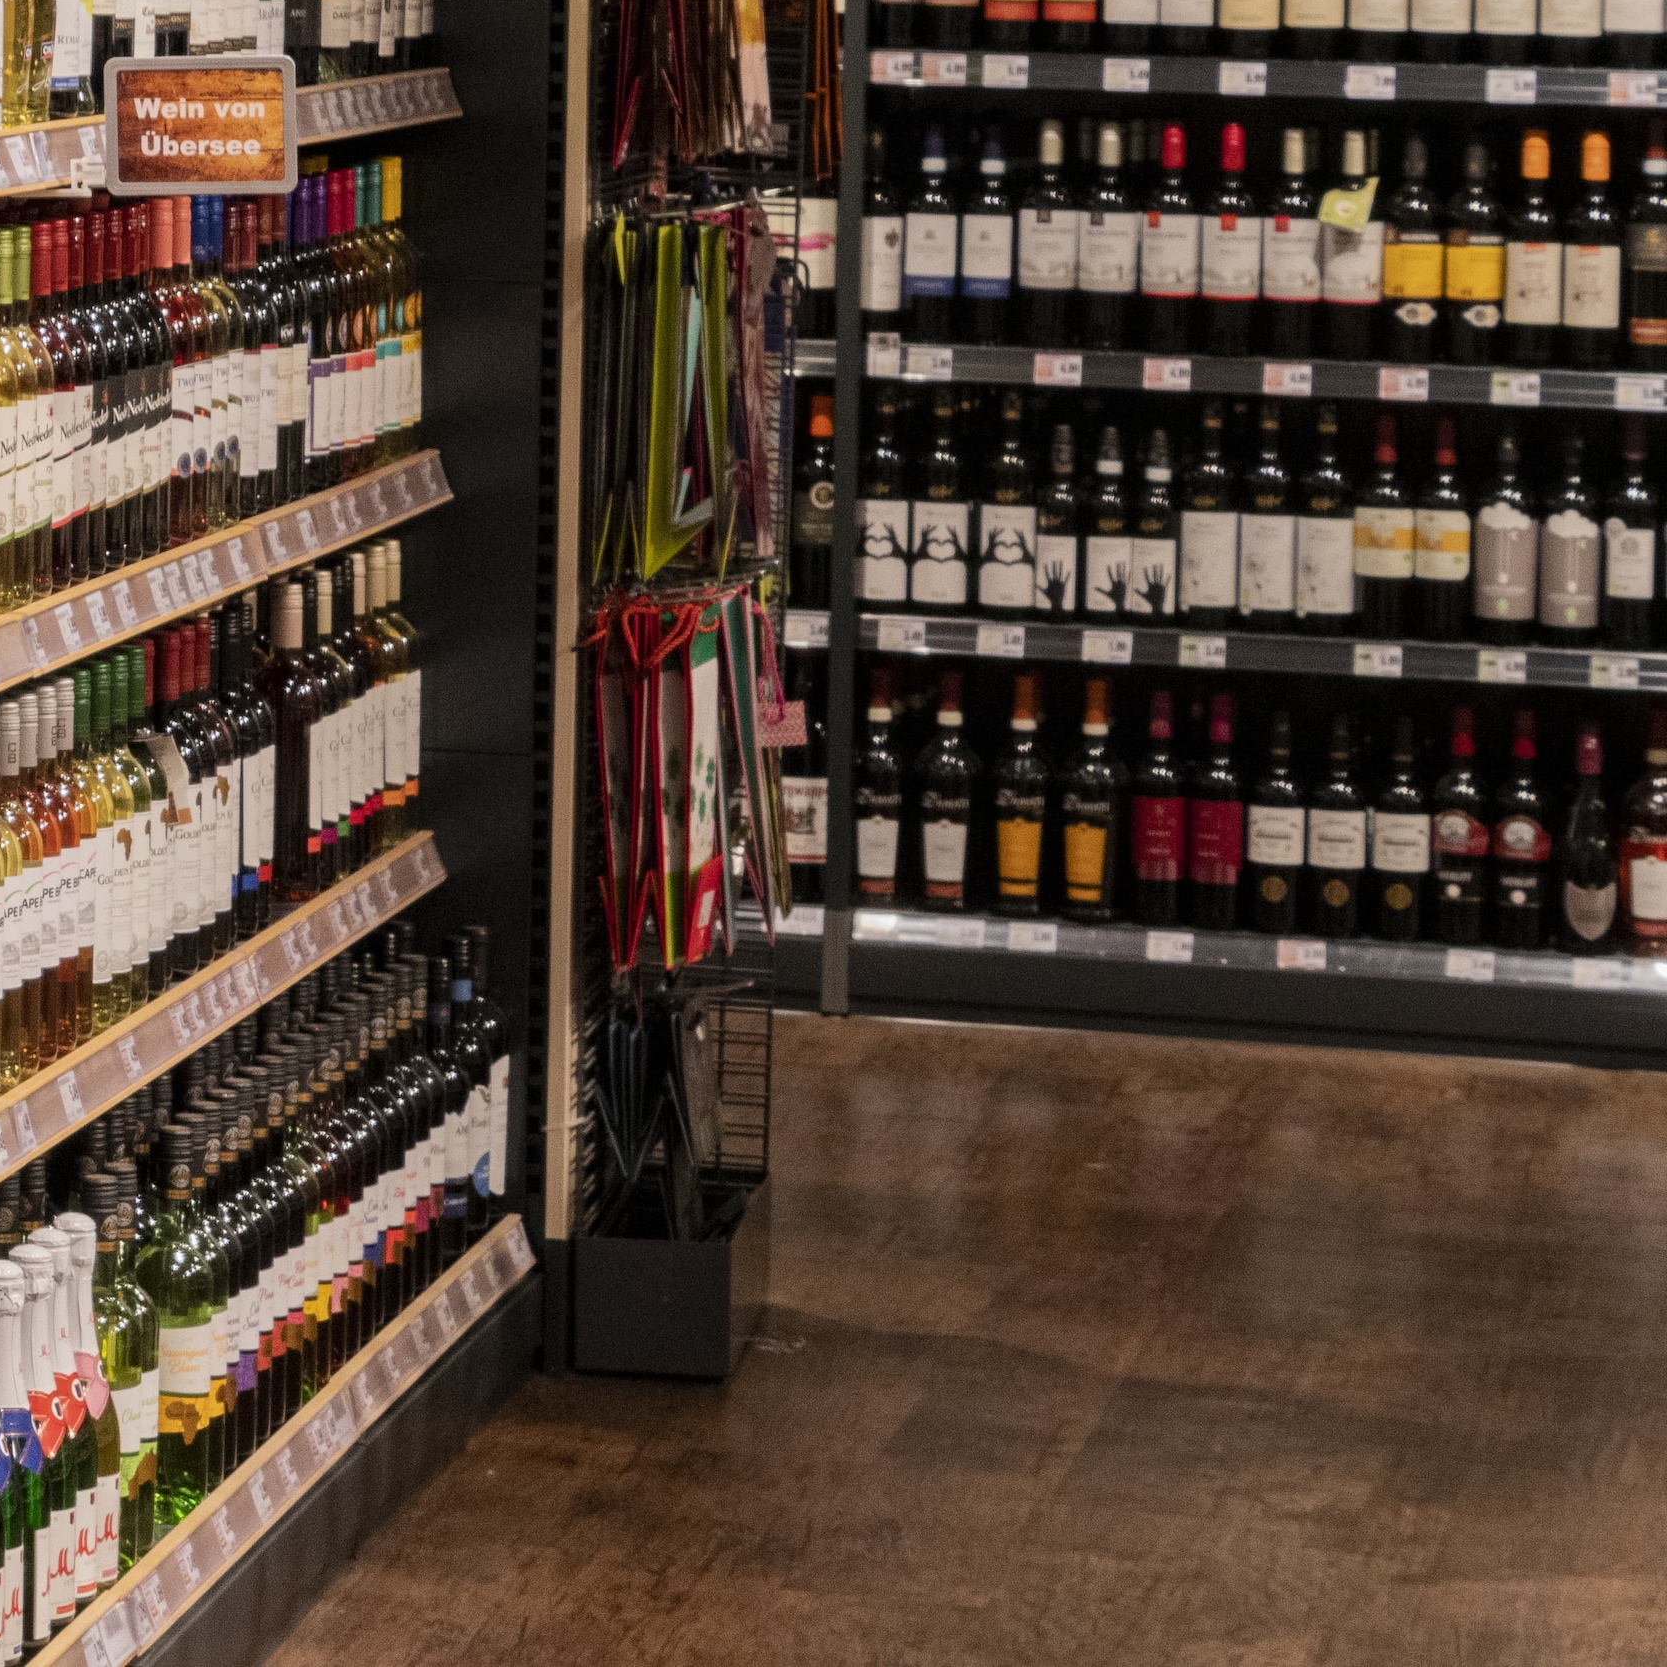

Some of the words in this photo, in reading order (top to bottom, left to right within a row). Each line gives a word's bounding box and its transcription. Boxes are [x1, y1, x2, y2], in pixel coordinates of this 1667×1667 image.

[133, 97, 205, 121] Wein
[215, 101, 266, 120] von
[141, 128, 262, 157] Übersee
